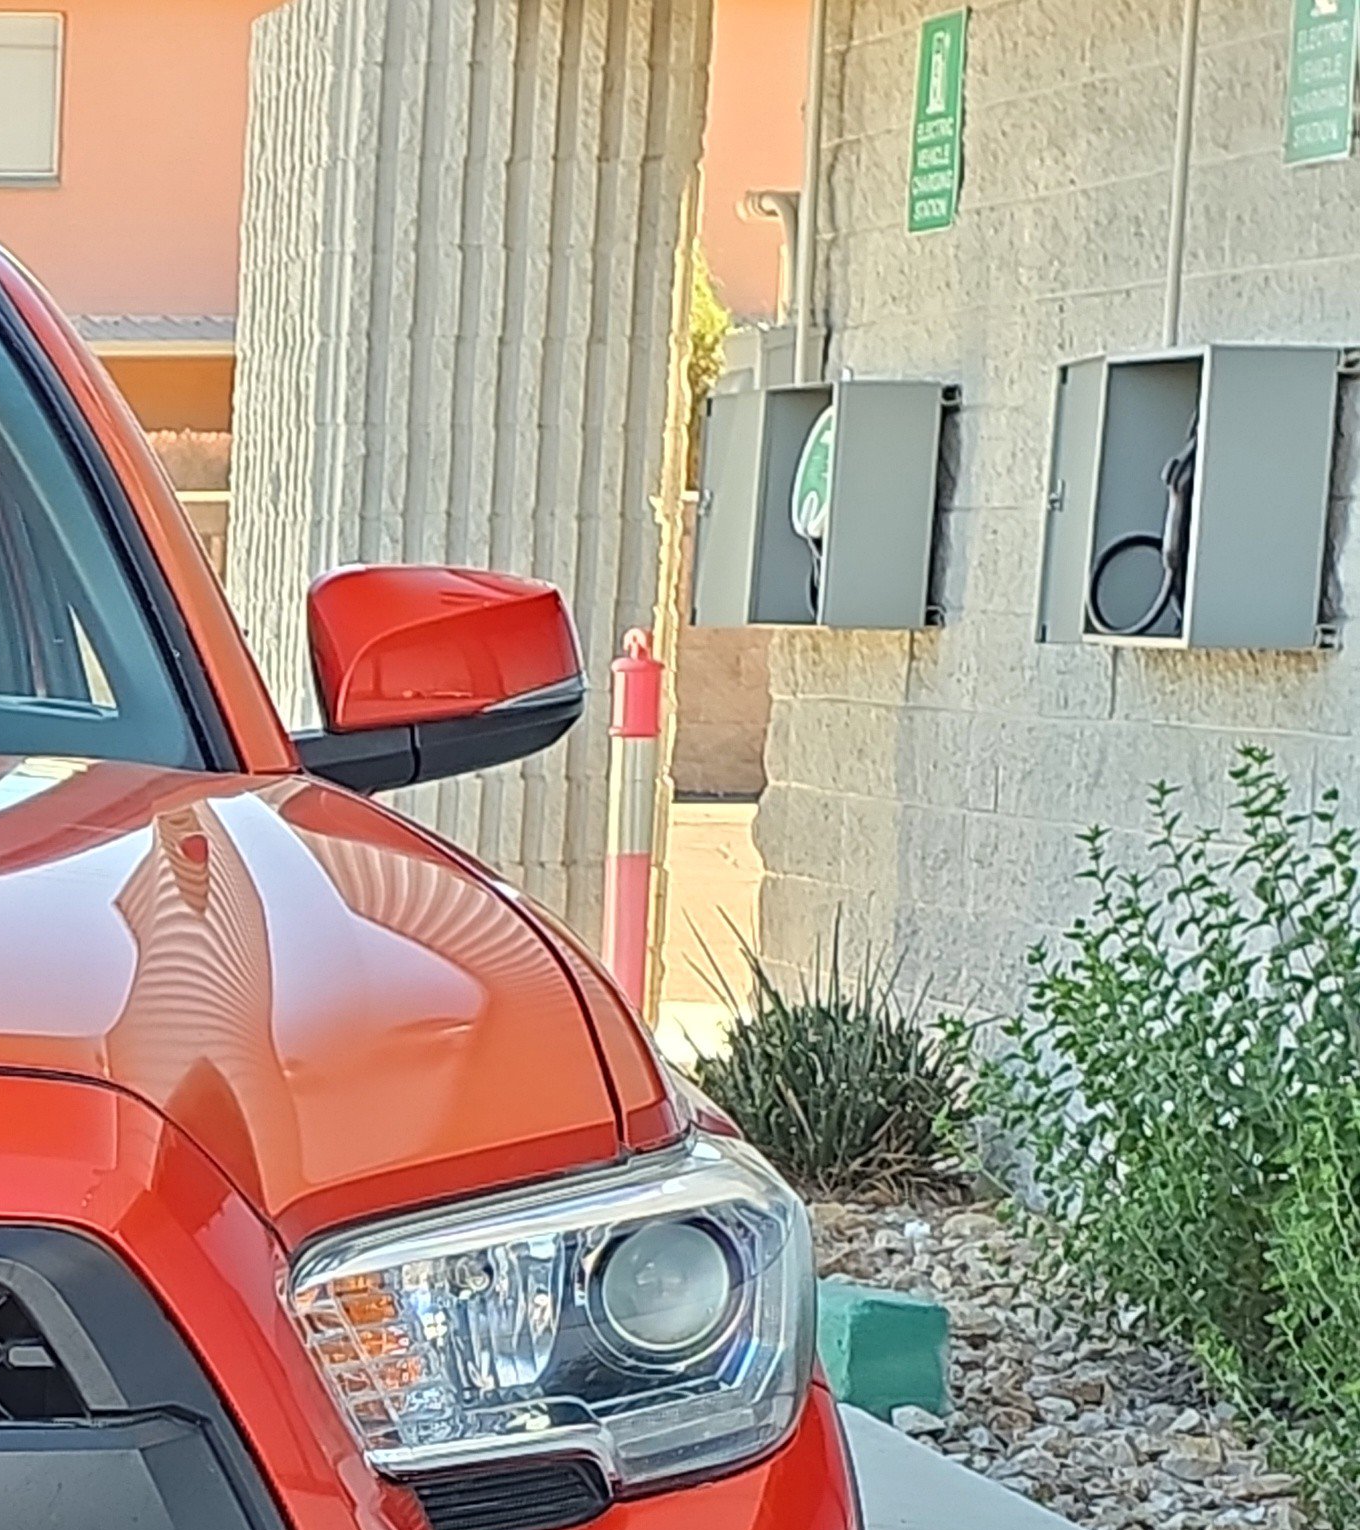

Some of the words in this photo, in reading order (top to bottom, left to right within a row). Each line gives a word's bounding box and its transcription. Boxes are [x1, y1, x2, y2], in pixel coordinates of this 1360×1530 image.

[1296, 19, 1349, 53] ELECTRIC
[1296, 52, 1344, 84] VEHICLE
[916, 117, 954, 143] ELECTRIC
[1292, 118, 1339, 148] STATION
[916, 143, 951, 169] VEHICLE
